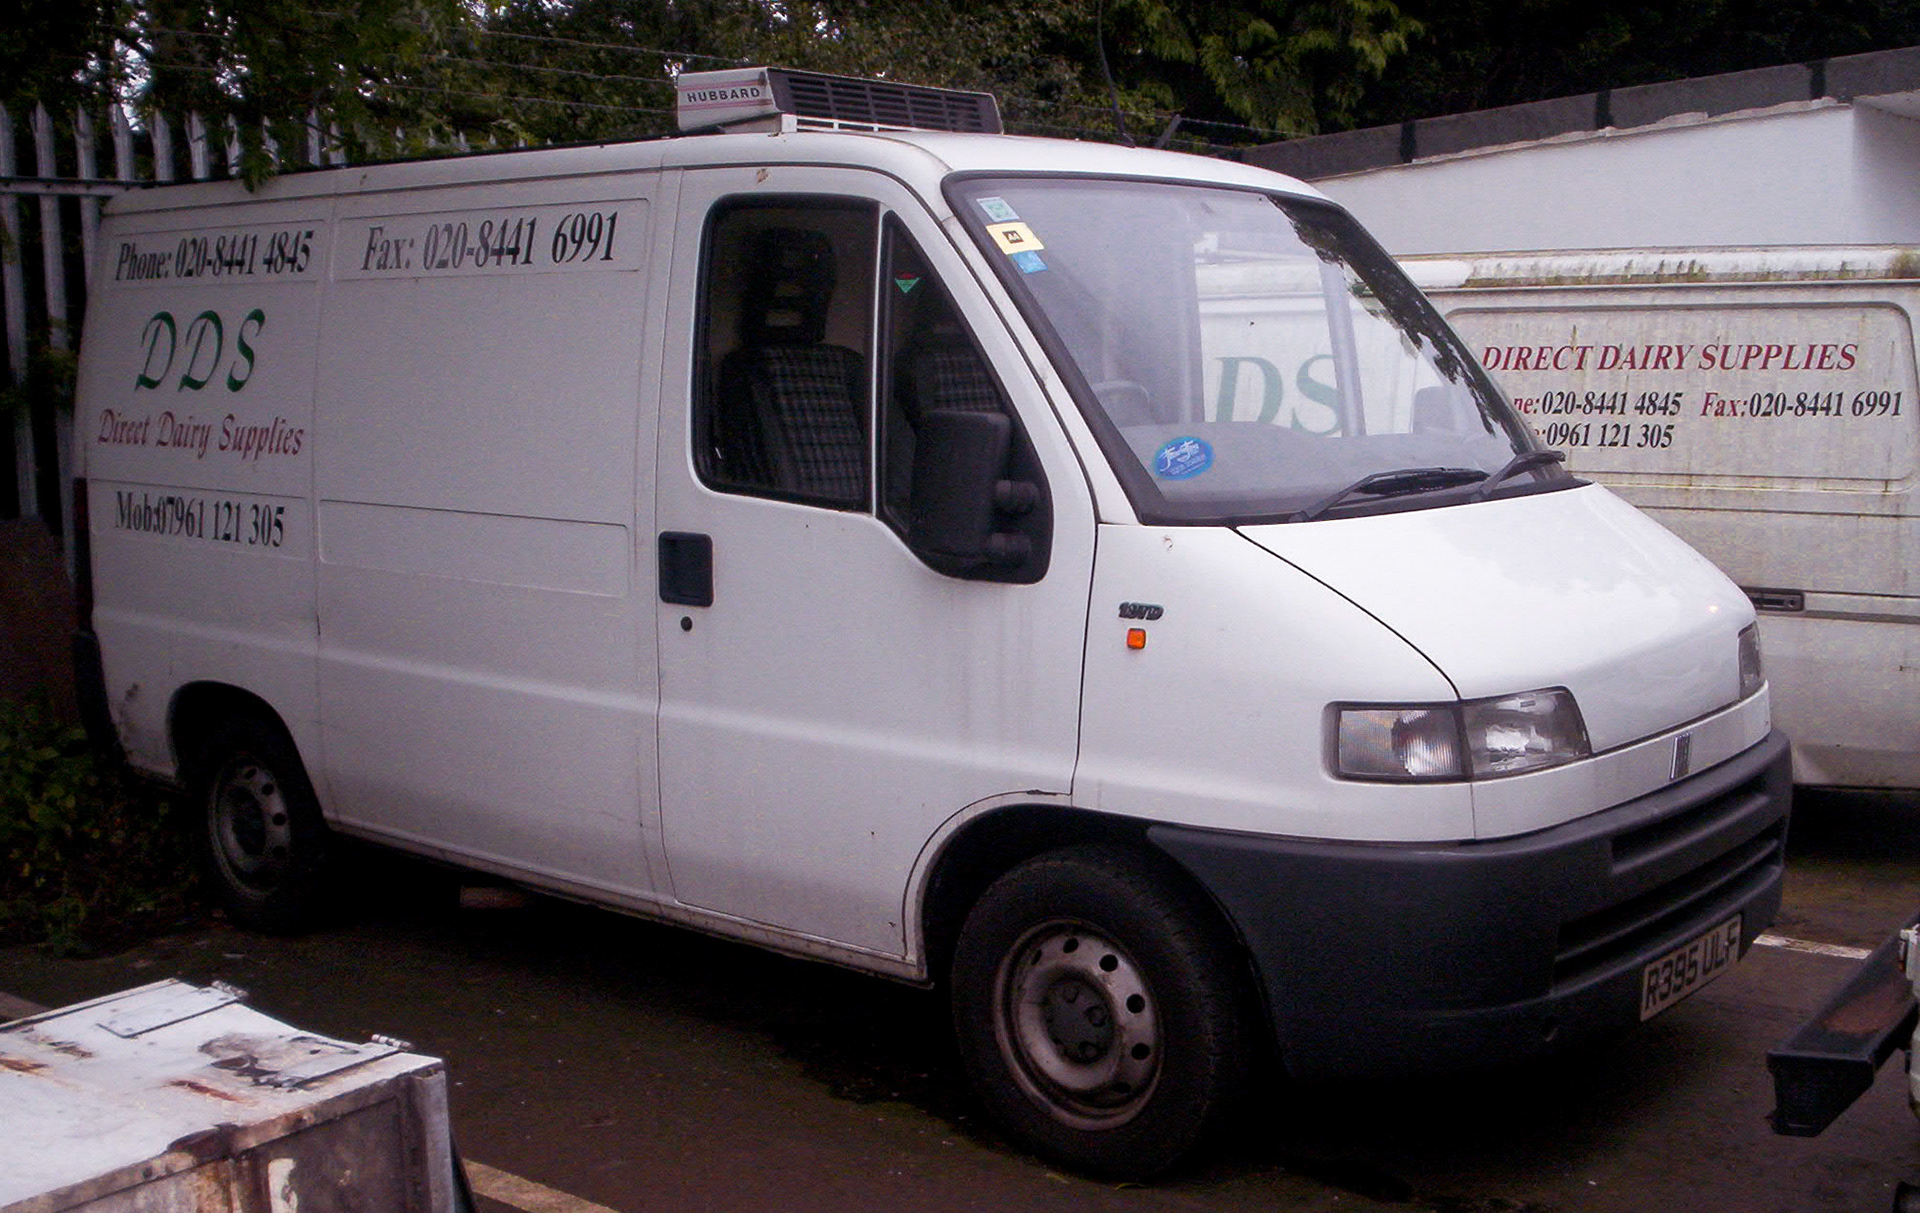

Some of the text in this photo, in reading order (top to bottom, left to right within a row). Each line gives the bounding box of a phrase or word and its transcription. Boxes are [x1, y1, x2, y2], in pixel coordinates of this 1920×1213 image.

[687, 87, 760, 103] HUBBARD
[115, 230, 315, 281] Phone: 020-8441 4845
[361, 211, 618, 270] Fax: 020-8441 6991
[134, 308, 266, 393] DDS
[1482, 343, 1858, 371] DIRECT DAIRY SUPPLIES
[1215, 354, 1341, 437] DS
[1634, 390, 1684, 416] 4845
[1851, 390, 1903, 417] 6991
[98, 408, 305, 461] Direct Dairy Supplies
[1597, 423, 1630, 447] 121
[1637, 423, 1675, 448] 305
[212, 500, 241, 543] 121
[248, 503, 285, 547] 305
[1645, 944, 1699, 1011] R395
